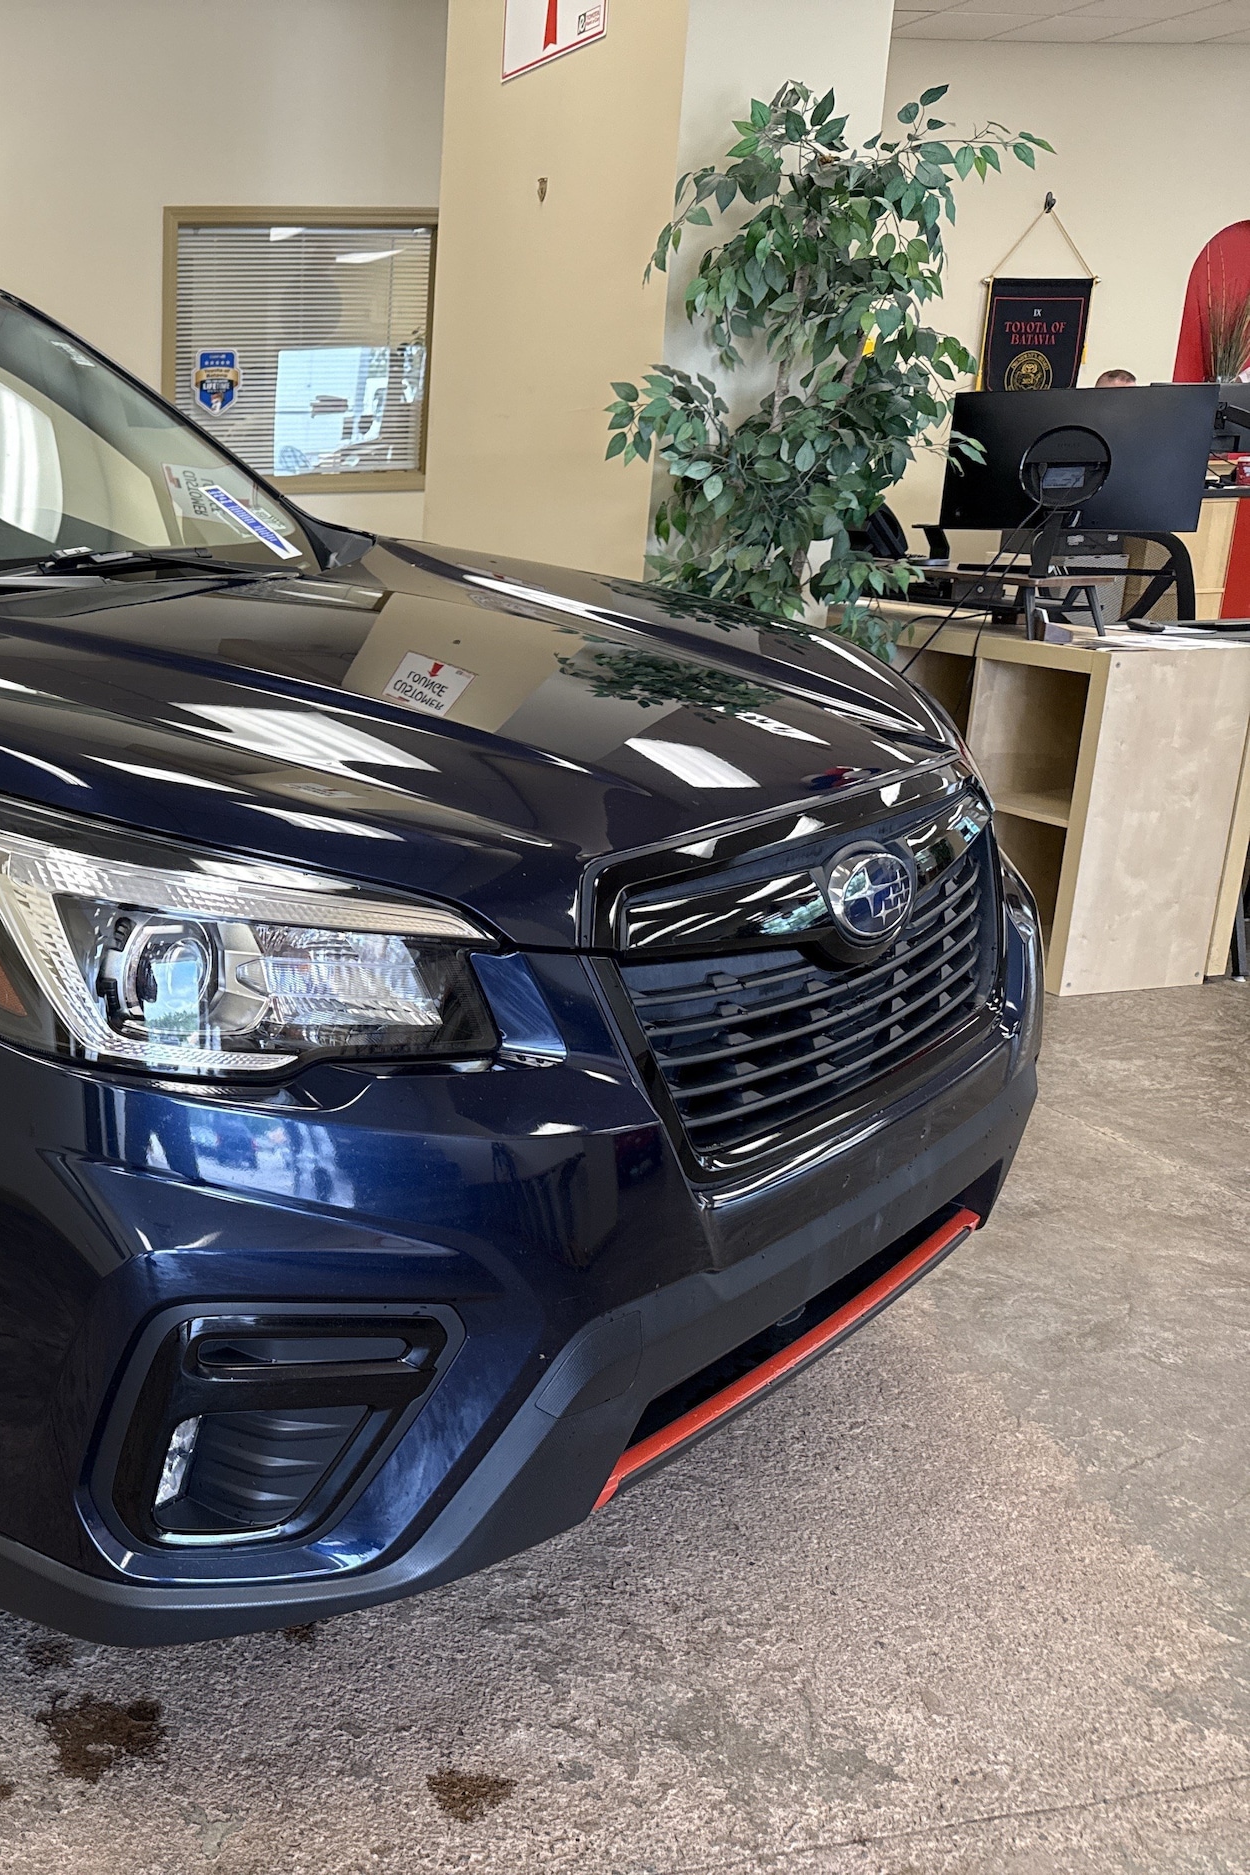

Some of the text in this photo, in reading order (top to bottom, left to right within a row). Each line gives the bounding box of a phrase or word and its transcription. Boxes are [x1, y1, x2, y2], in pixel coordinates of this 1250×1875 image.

[1004, 321, 1067, 333] TOYOTA OF
[1010, 333, 1056, 345] BATAVIA
